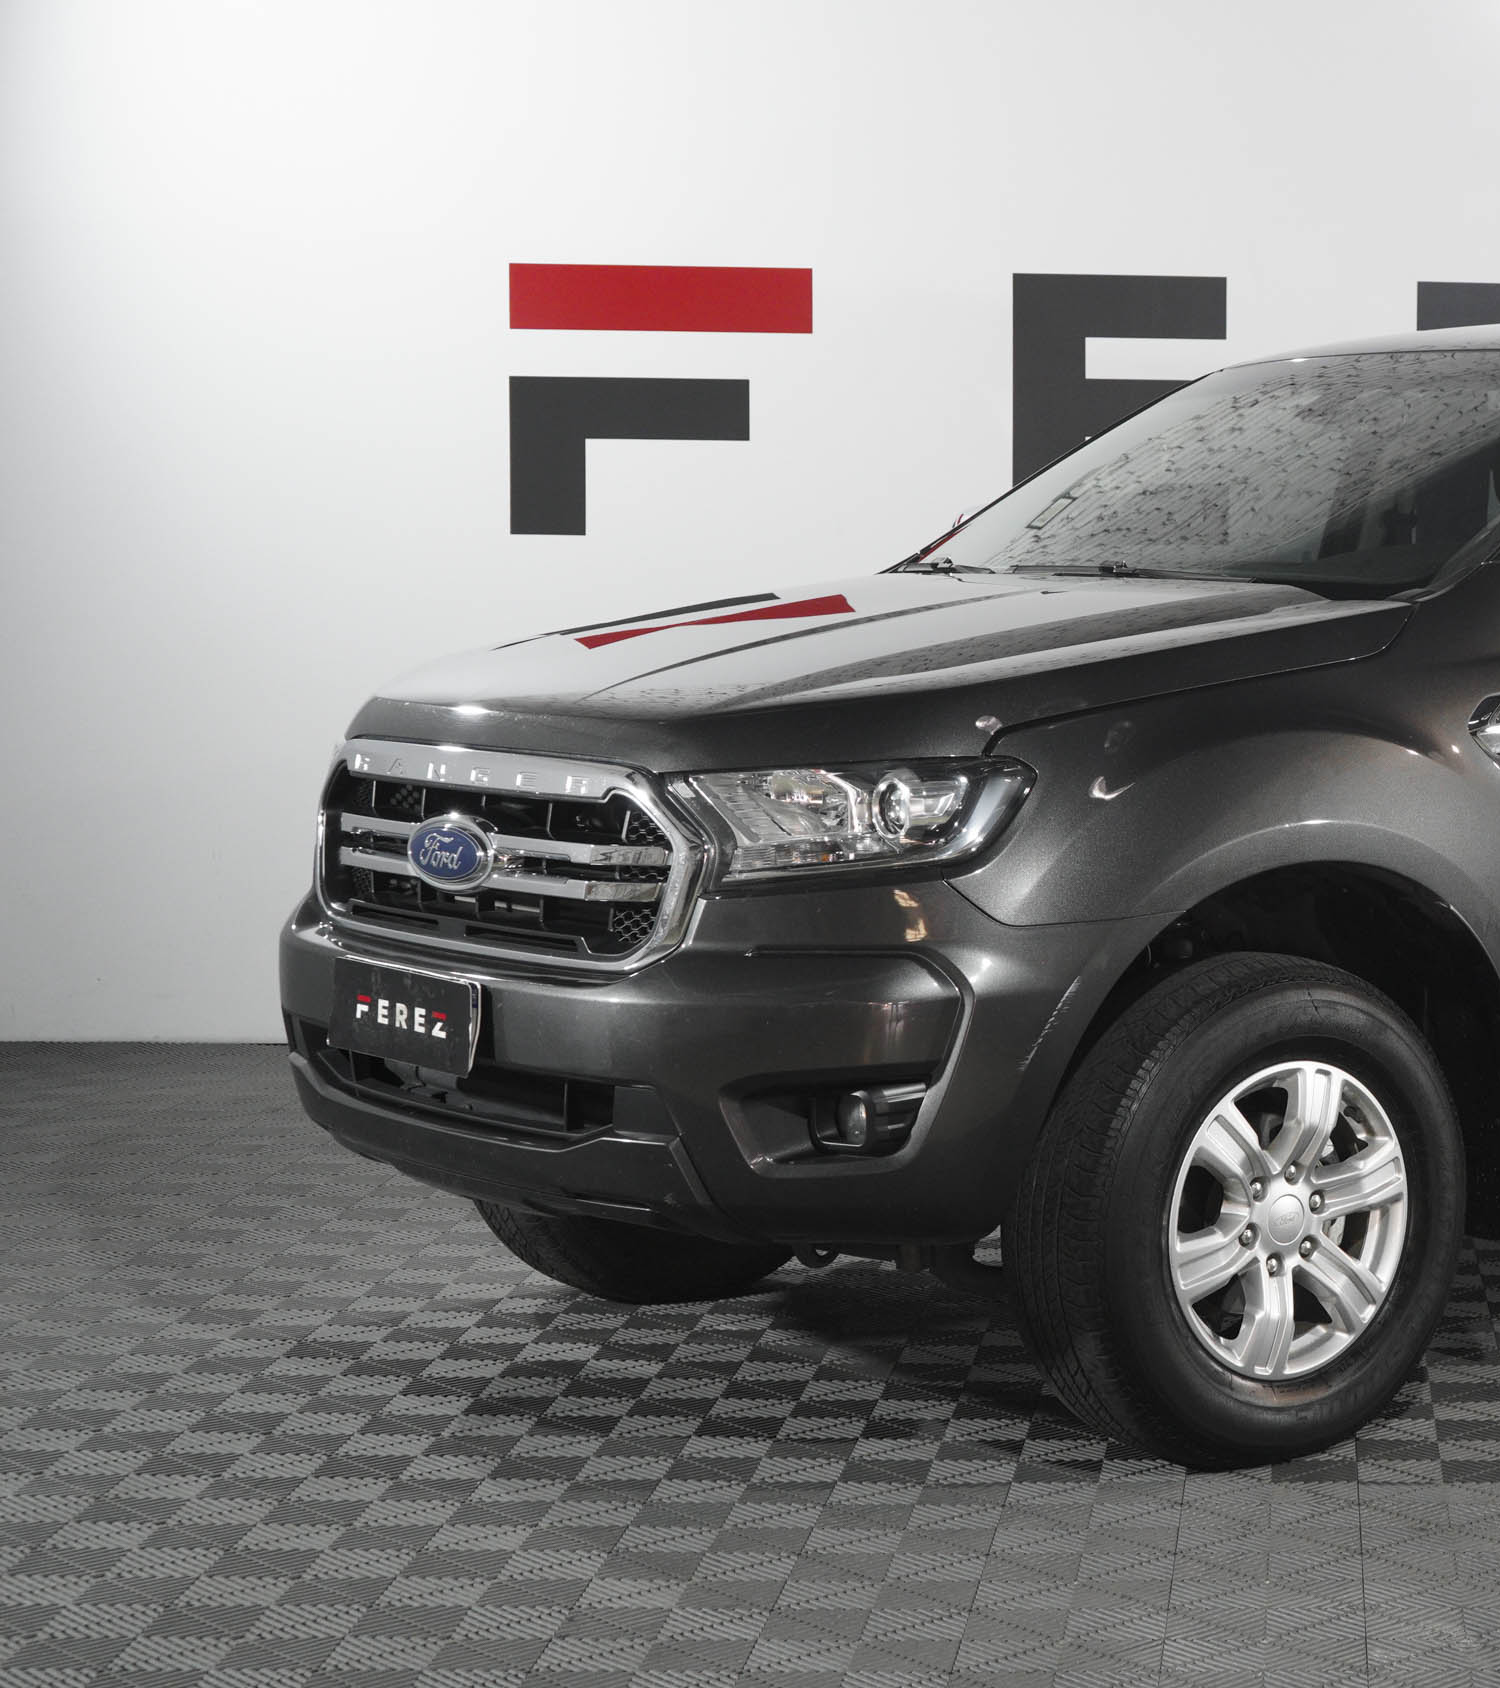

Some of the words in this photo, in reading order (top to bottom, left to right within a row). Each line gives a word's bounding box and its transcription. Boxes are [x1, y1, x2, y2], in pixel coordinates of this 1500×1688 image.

[354, 753, 590, 795] RANGER
[420, 832, 463, 870] Ford
[355, 994, 448, 1039] FEREZ
